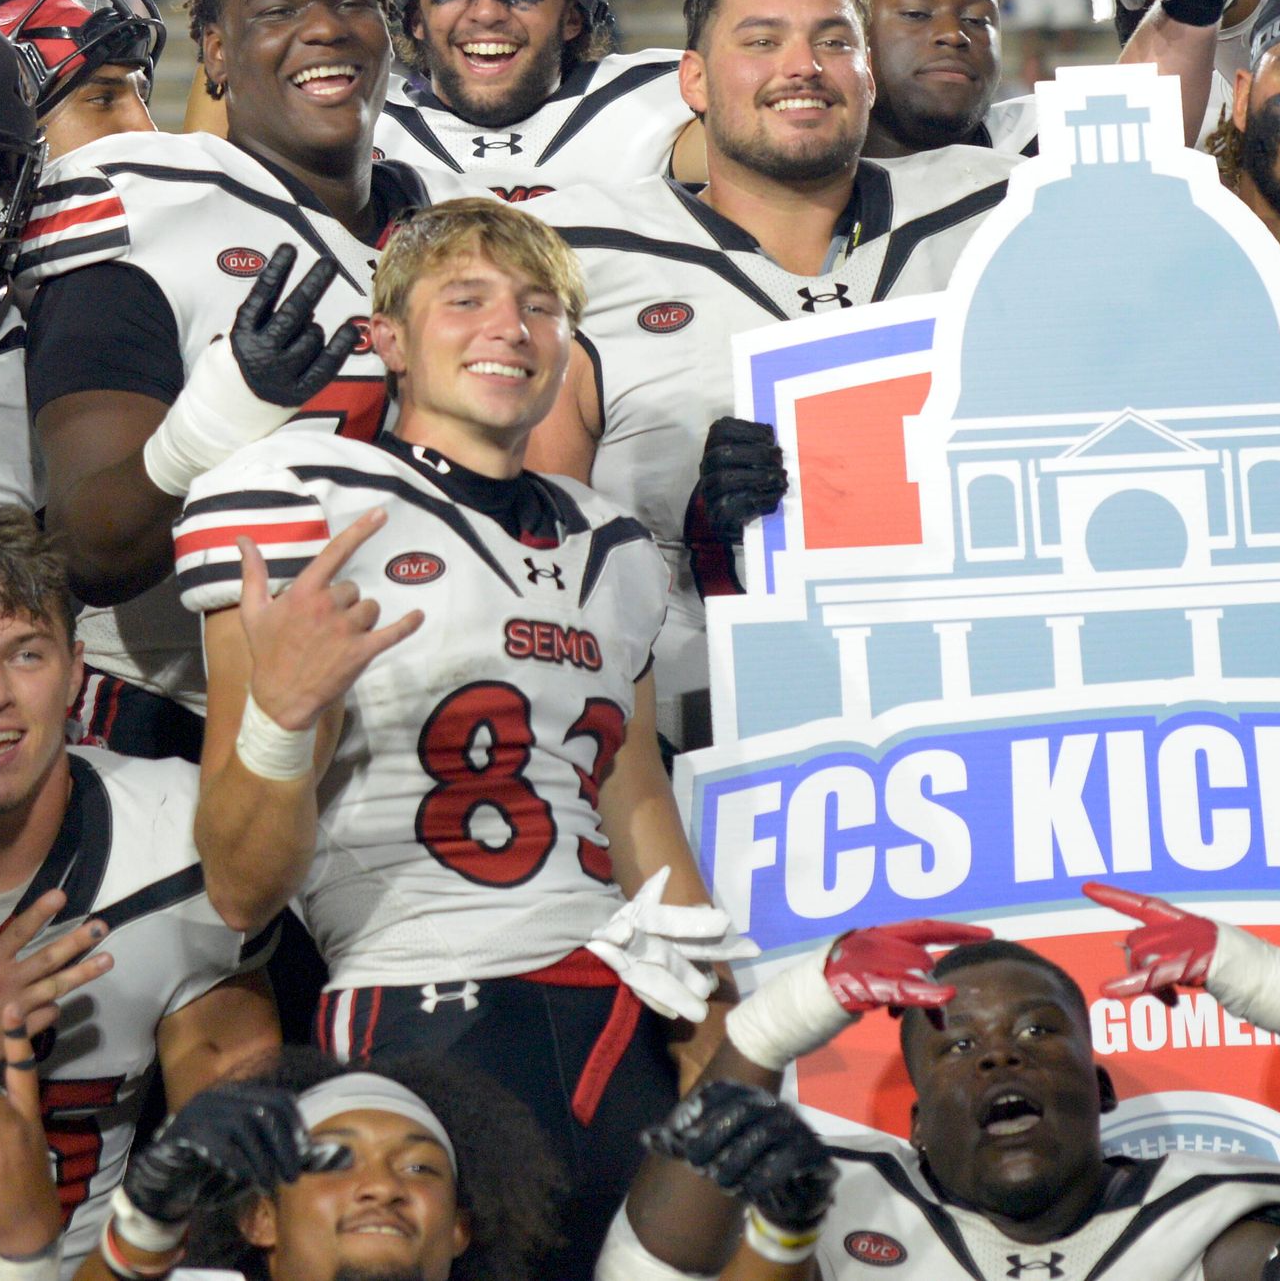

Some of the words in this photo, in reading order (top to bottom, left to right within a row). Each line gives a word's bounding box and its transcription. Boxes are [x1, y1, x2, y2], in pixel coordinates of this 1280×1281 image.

[230, 257, 256, 267] OVC
[650, 310, 679, 325] OVC
[399, 561, 430, 576] OVC
[503, 617, 603, 672] SEMO
[711, 750, 972, 935] FCS
[858, 1240, 892, 1258] OVC
